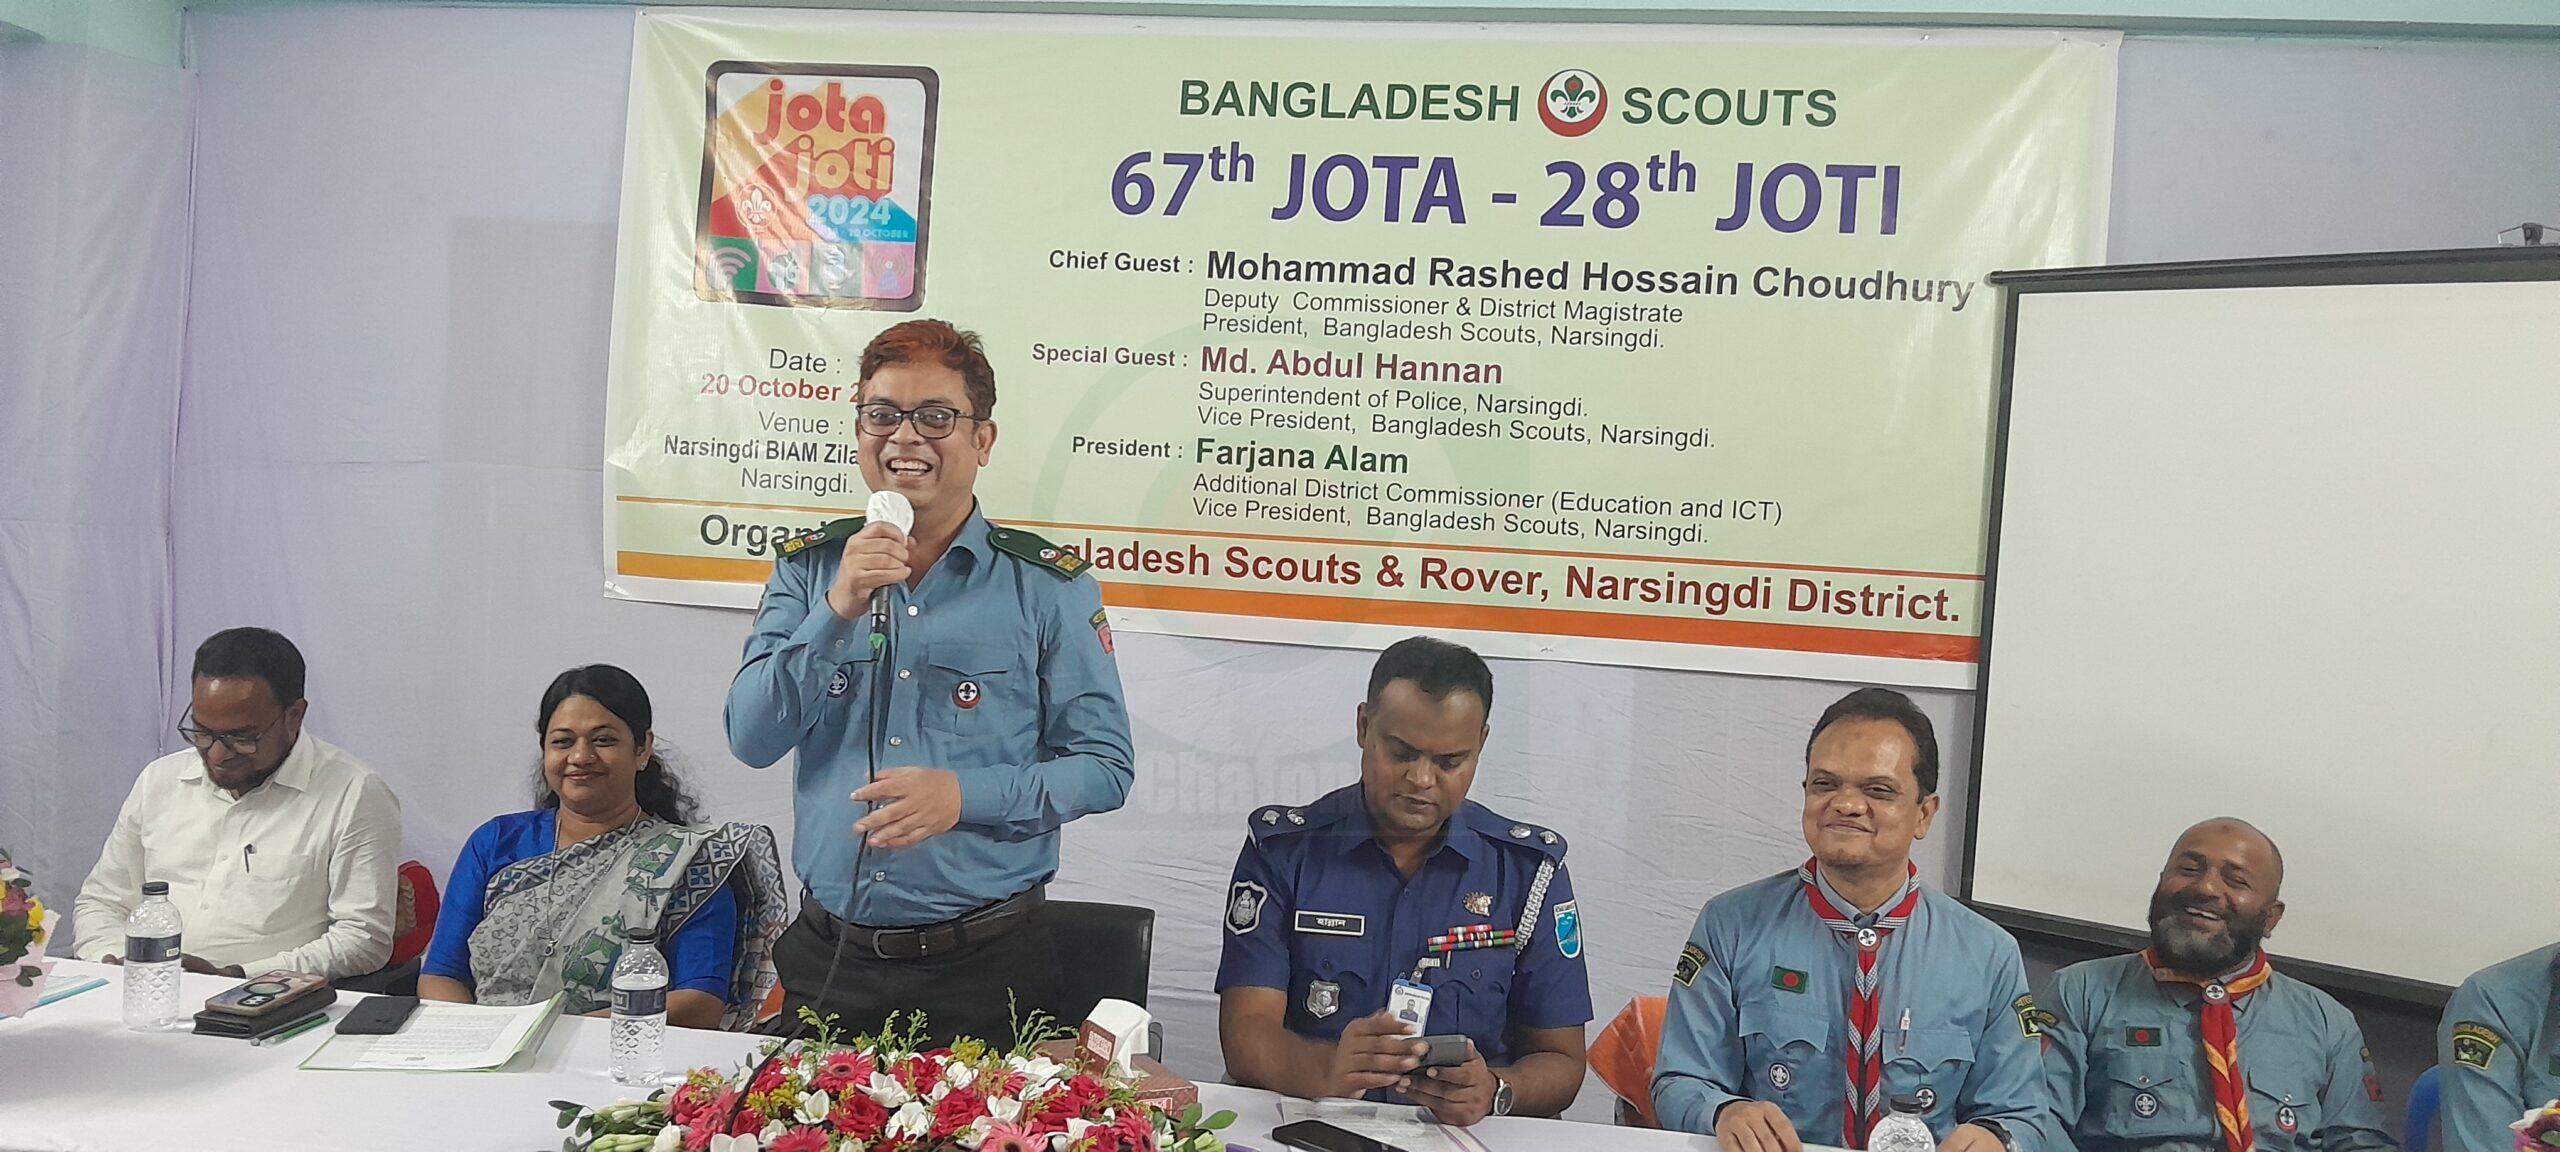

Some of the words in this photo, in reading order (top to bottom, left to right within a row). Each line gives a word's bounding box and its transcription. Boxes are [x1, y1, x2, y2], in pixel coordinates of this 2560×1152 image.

[754, 78, 885, 145] jota
[1180, 80, 1519, 121] BANGLADESH
[1622, 87, 1836, 127] SCOUTS
[789, 134, 894, 203] joti
[1112, 141, 1254, 216] 67th
[1271, 154, 1466, 224] JOTA
[1492, 193, 1516, 203] -
[1540, 150, 1696, 228] 28th
[1715, 163, 1900, 235] JOTI
[808, 196, 891, 225] 2024
[1050, 250, 1108, 269] Chief
[1115, 253, 1180, 272] Guest
[1208, 251, 1415, 285] Mohammad
[1429, 258, 1568, 290] Rashed
[1583, 262, 1737, 295] Hossain
[1753, 266, 1974, 311] Choudhury
[1205, 288, 1279, 314] Deputy
[1293, 292, 1449, 315] Commissioner
[1456, 297, 1471, 316] &
[1481, 298, 1556, 319] District
[1565, 300, 1682, 326] Magistrate
[1204, 313, 1307, 338] President,
[1324, 317, 1451, 342] Bangladesh
[1461, 322, 1541, 347] Scouts,
[1552, 325, 1663, 352] Narsingdi.
[770, 349, 826, 373] Date
[1033, 343, 1107, 365] Special
[1115, 348, 1175, 366] Guest
[1202, 346, 1256, 374] Md.
[1266, 349, 1363, 378] Abdul
[1376, 353, 1501, 384] Hannan
[700, 373, 729, 395] 20
[739, 375, 841, 401] October
[1199, 382, 1360, 409] Superintendent
[1368, 389, 1389, 408] of
[1396, 390, 1467, 415] Police,
[1477, 393, 1587, 420] Narsingdi.
[759, 411, 829, 434] Venue
[1198, 406, 1242, 426] Vice
[1251, 408, 1355, 434] President,
[1372, 414, 1500, 439] Bangladesh
[1510, 420, 1590, 445] Scouts,
[1601, 424, 1714, 451] Narsingdi.
[665, 435, 759, 463] Narsingdi
[766, 440, 817, 462] BIAM
[1073, 436, 1170, 458] President
[1197, 438, 1314, 473] Farjana
[1324, 445, 1407, 473] Alam
[742, 468, 853, 497] Narsingdi.
[1193, 473, 1297, 496] Additional
[1306, 479, 1378, 500] District
[1387, 483, 1544, 508] Commissioner
[1552, 491, 1671, 515] (Education
[1681, 499, 1722, 518] and
[1733, 500, 1781, 526] ICT)
[1193, 497, 1237, 517] Vice
[1246, 500, 1350, 526] President,
[1367, 506, 1494, 532] Bangladesh
[1504, 514, 1584, 539] Scouts,
[1595, 518, 1707, 546] Narsingdi.
[700, 514, 827, 556] Orga
[1225, 546, 1361, 585] Scouts
[1377, 555, 1404, 587] &
[1421, 557, 1548, 602] Rover,
[1566, 566, 1771, 615] Narsingdi
[1788, 579, 1958, 621] District.
